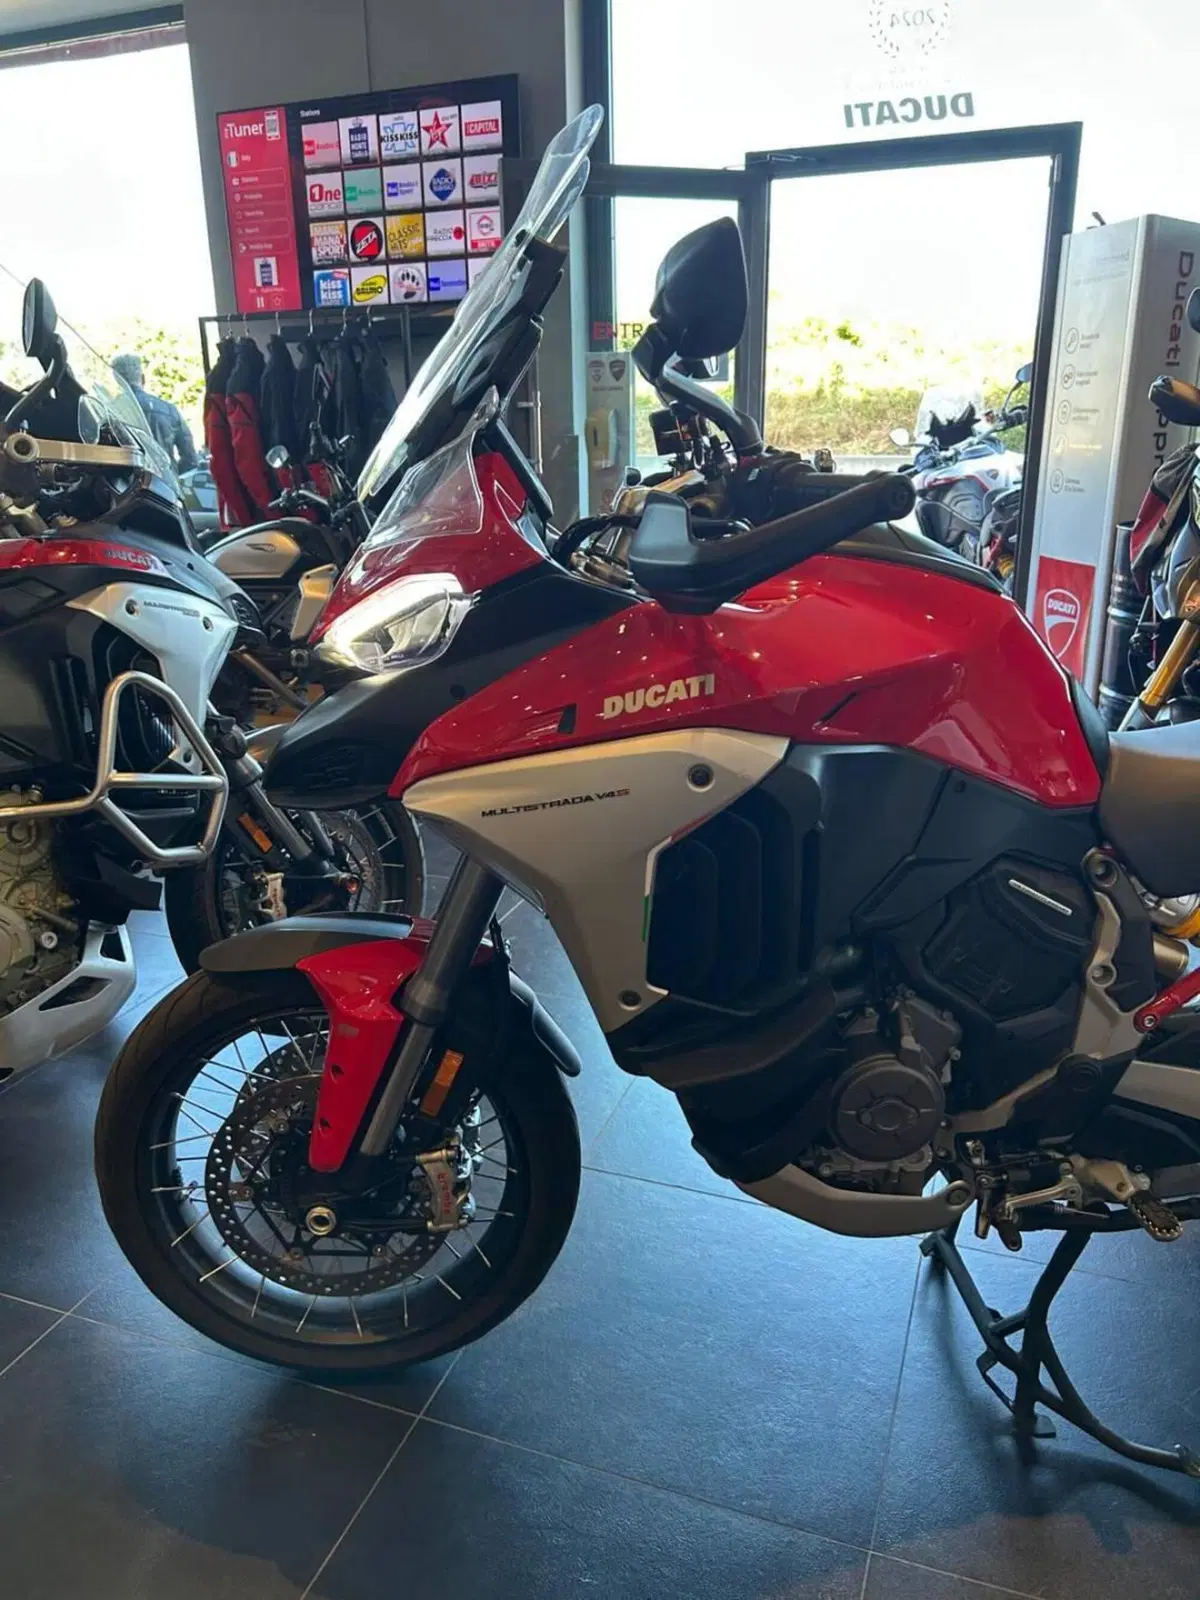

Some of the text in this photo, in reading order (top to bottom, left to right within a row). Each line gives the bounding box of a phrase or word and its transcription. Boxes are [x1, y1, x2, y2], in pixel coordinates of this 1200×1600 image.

[1165, 250, 1194, 367] Ducati
[592, 321, 644, 341] ENTR
[1047, 598, 1076, 615] DUCATI
[602, 673, 715, 720] DUCATI
[481, 794, 594, 818] MULTISTRADA
